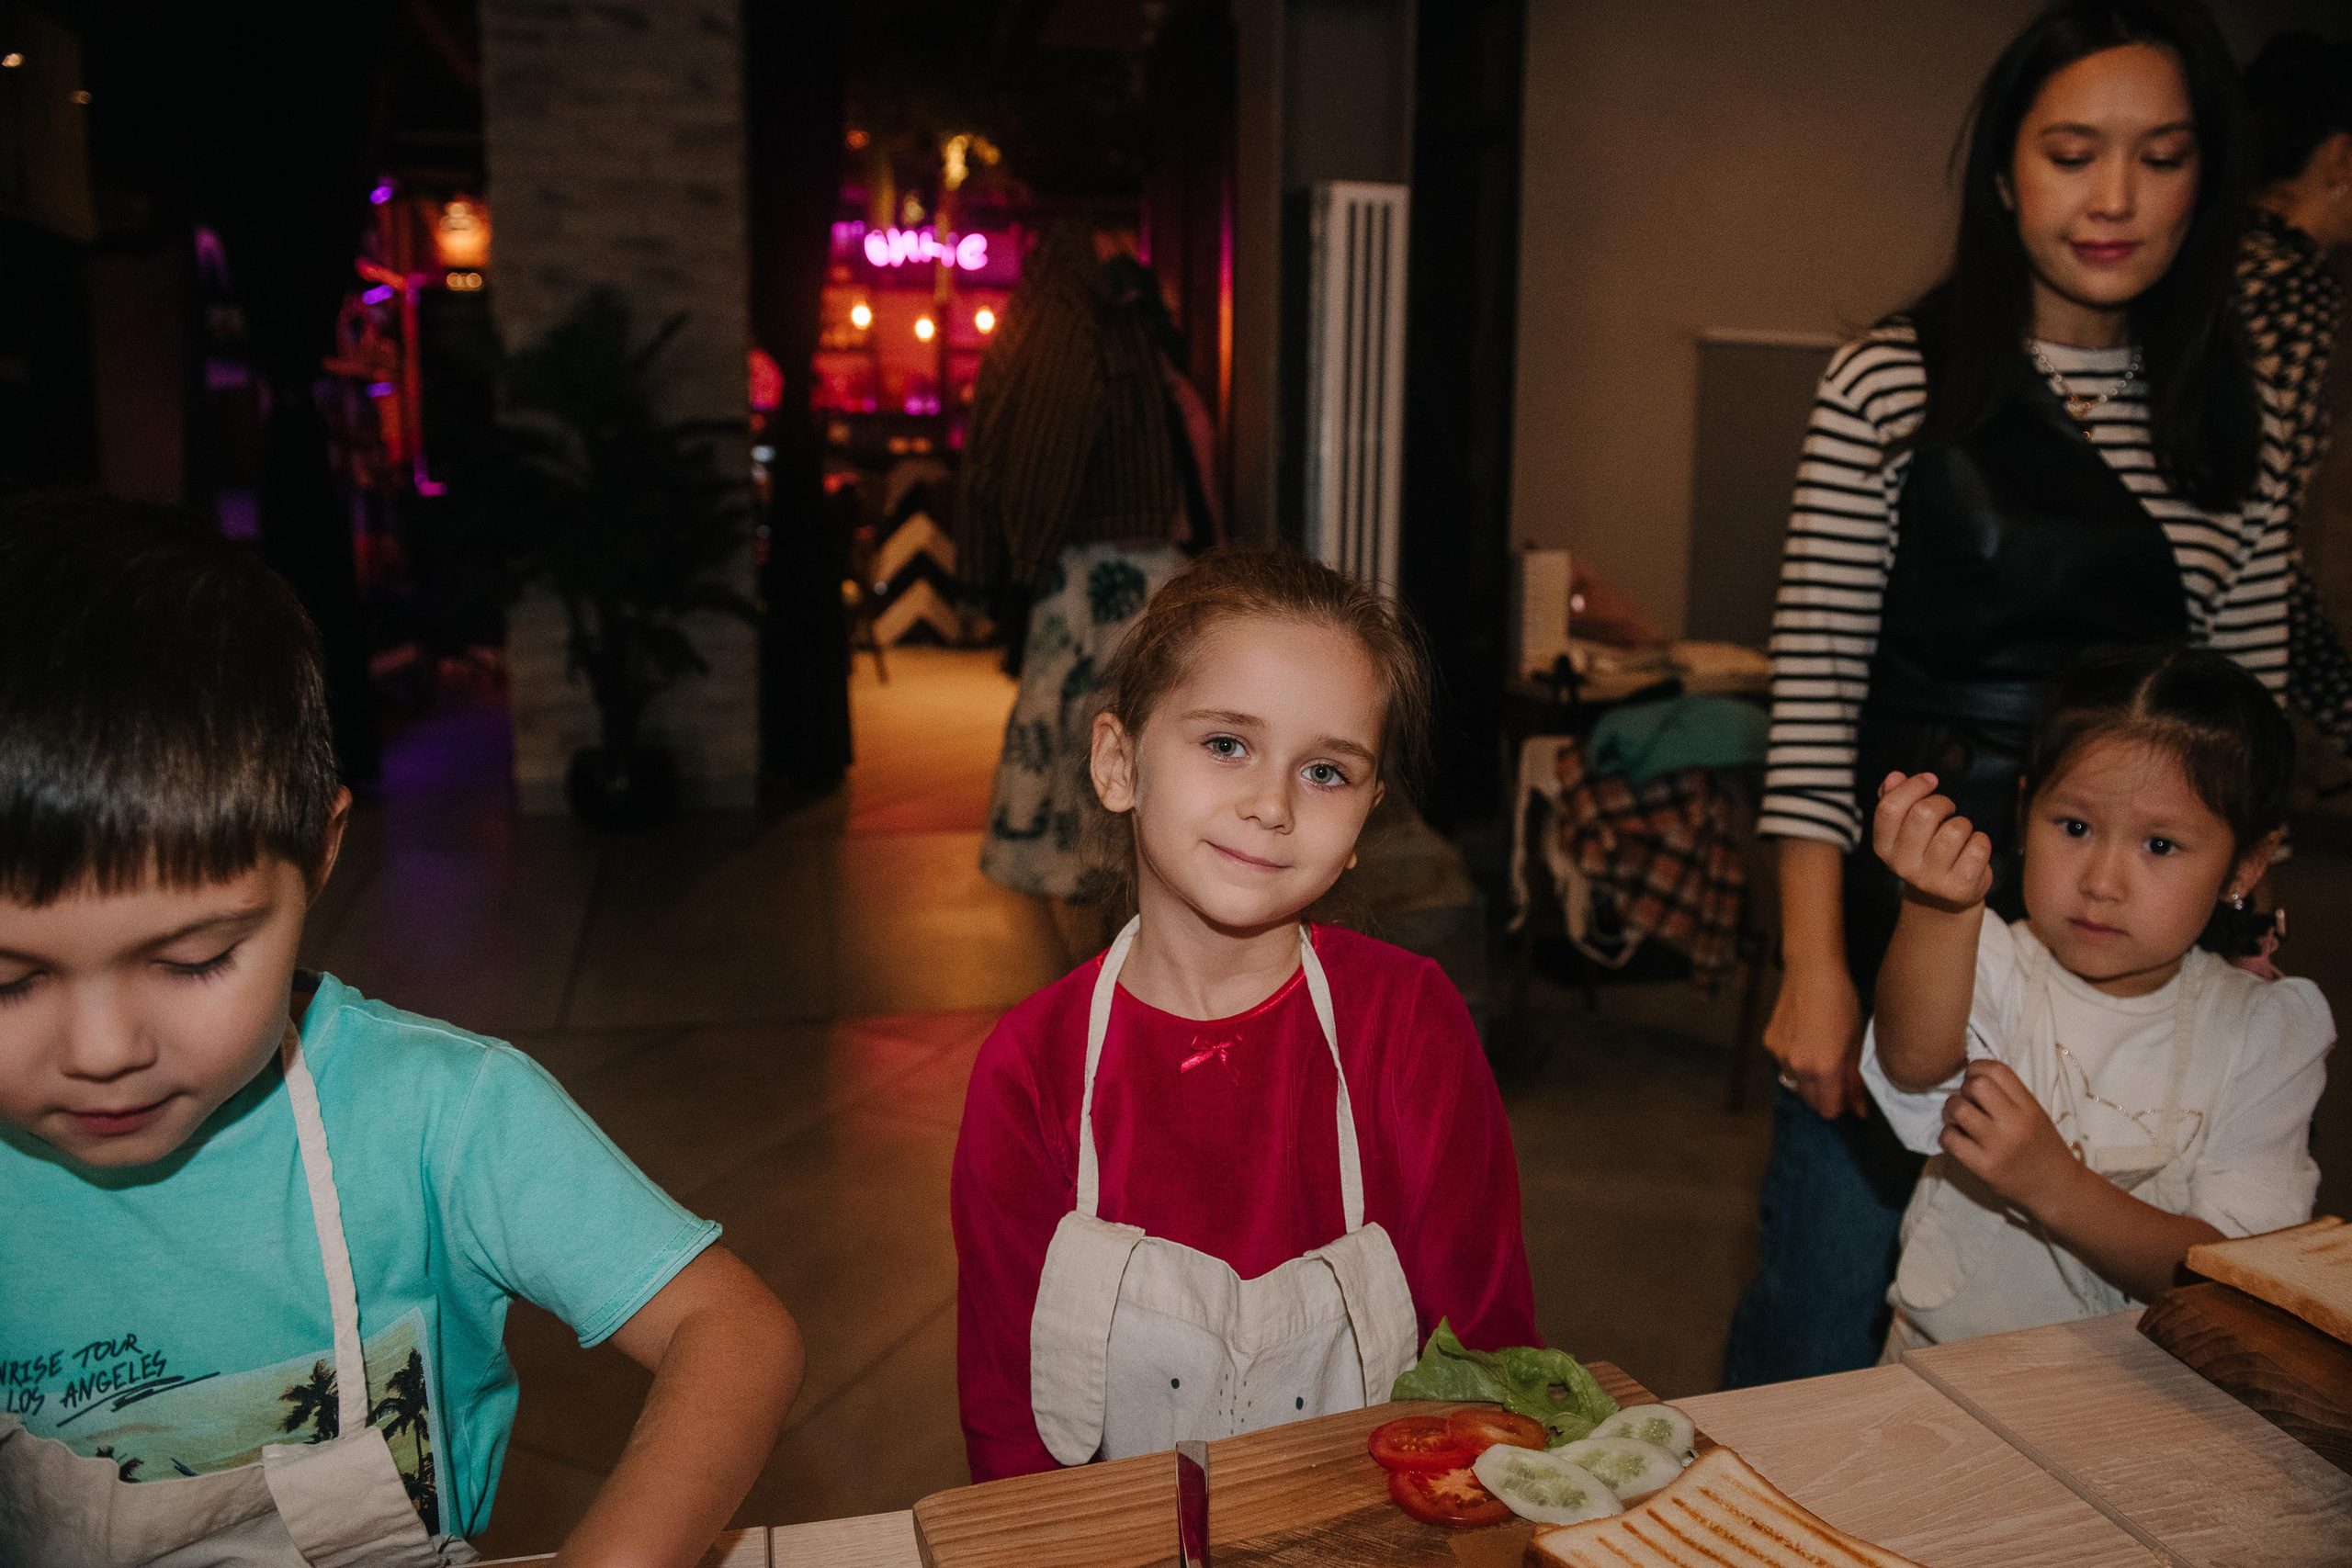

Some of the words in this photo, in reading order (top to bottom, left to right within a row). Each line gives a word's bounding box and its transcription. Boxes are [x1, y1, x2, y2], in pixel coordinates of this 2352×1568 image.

[72, 1333, 142, 1368] TOUR
[6, 1386, 45, 1416] LOS
[60, 1349, 166, 1408] ANGELES
